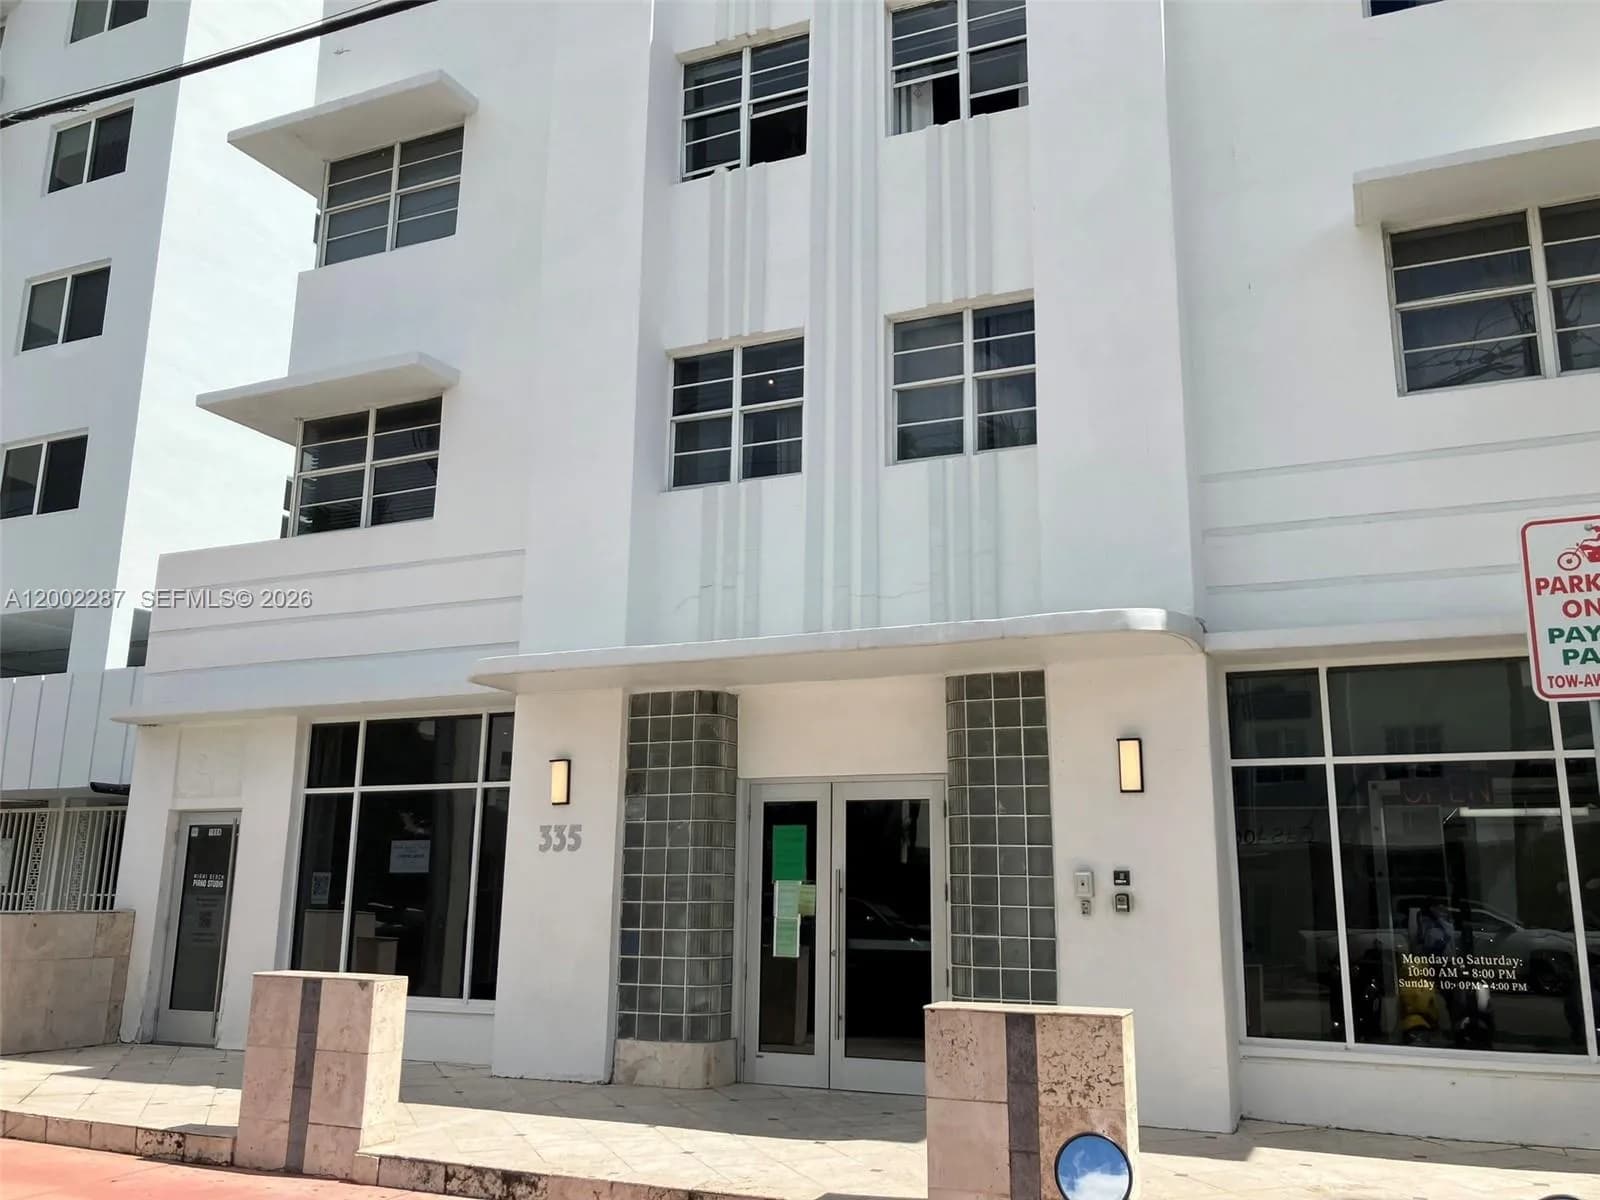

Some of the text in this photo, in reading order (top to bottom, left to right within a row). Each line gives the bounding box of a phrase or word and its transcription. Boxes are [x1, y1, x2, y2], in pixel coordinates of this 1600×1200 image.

[1548, 625, 1600, 644] PAY
[1562, 647, 1600, 666] PA
[539, 824, 582, 852] 335
[193, 879, 224, 888] PIANO STUDIO
[1402, 953, 1523, 968] Monday to Saturday:
[1408, 967, 1435, 977] 10:00
[1439, 968, 1458, 978] AM
[1472, 968, 1495, 979] 8:00
[1498, 969, 1517, 980] PM
[1399, 978, 1435, 990] Sunday
[1490, 982, 1510, 991] 4:00
[1512, 982, 1528, 992] PM
